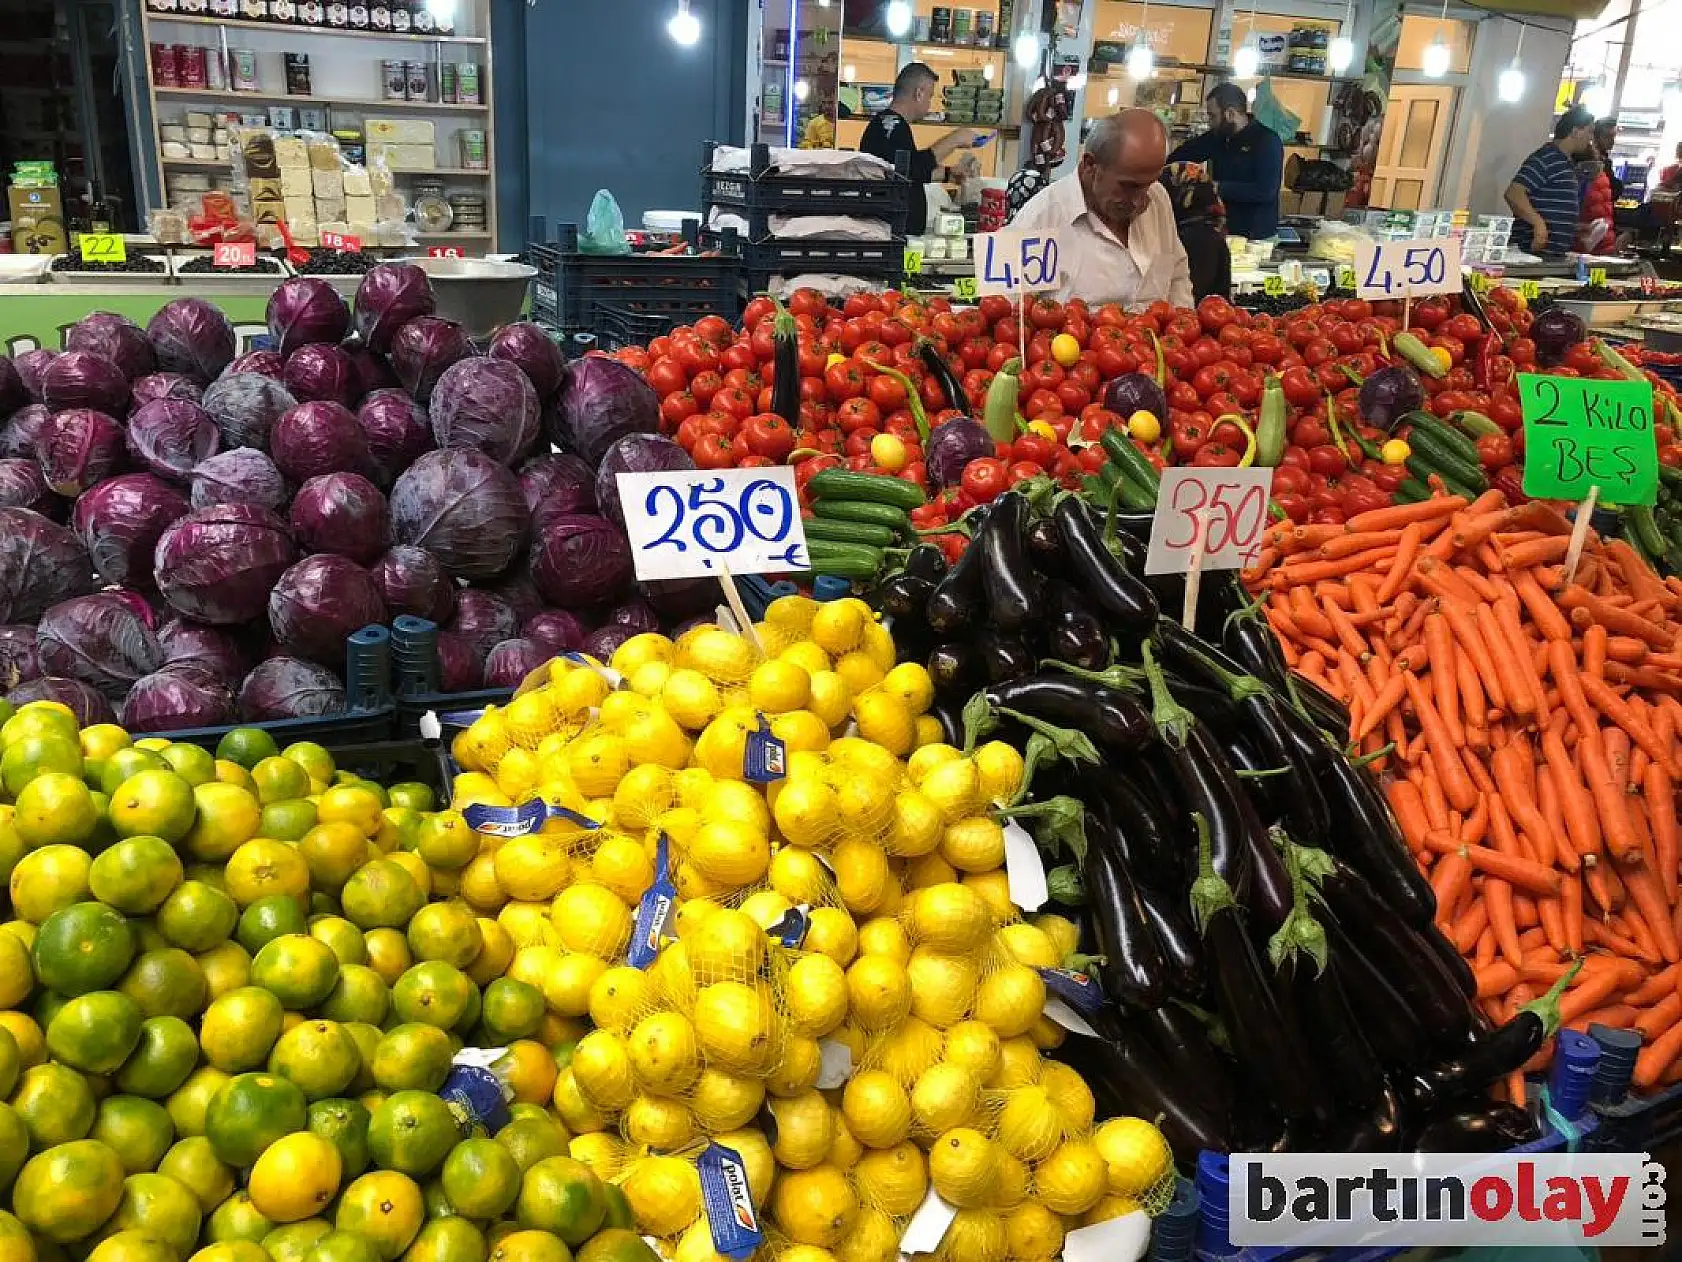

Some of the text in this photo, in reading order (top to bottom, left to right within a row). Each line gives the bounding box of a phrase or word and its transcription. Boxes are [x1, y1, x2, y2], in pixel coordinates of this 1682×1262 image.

[85, 236, 119, 254] 22
[324, 234, 342, 247] 18
[219, 246, 241, 263] 20
[906, 252, 917, 270] 6
[984, 235, 1058, 289] 4.50
[1363, 245, 1446, 294] 4.50
[960, 279, 976, 296] 15
[1266, 277, 1283, 290] 22
[1534, 380, 1568, 427] 2
[1552, 438, 1637, 486] BEŞ
[721, 1163, 744, 1201] polat
